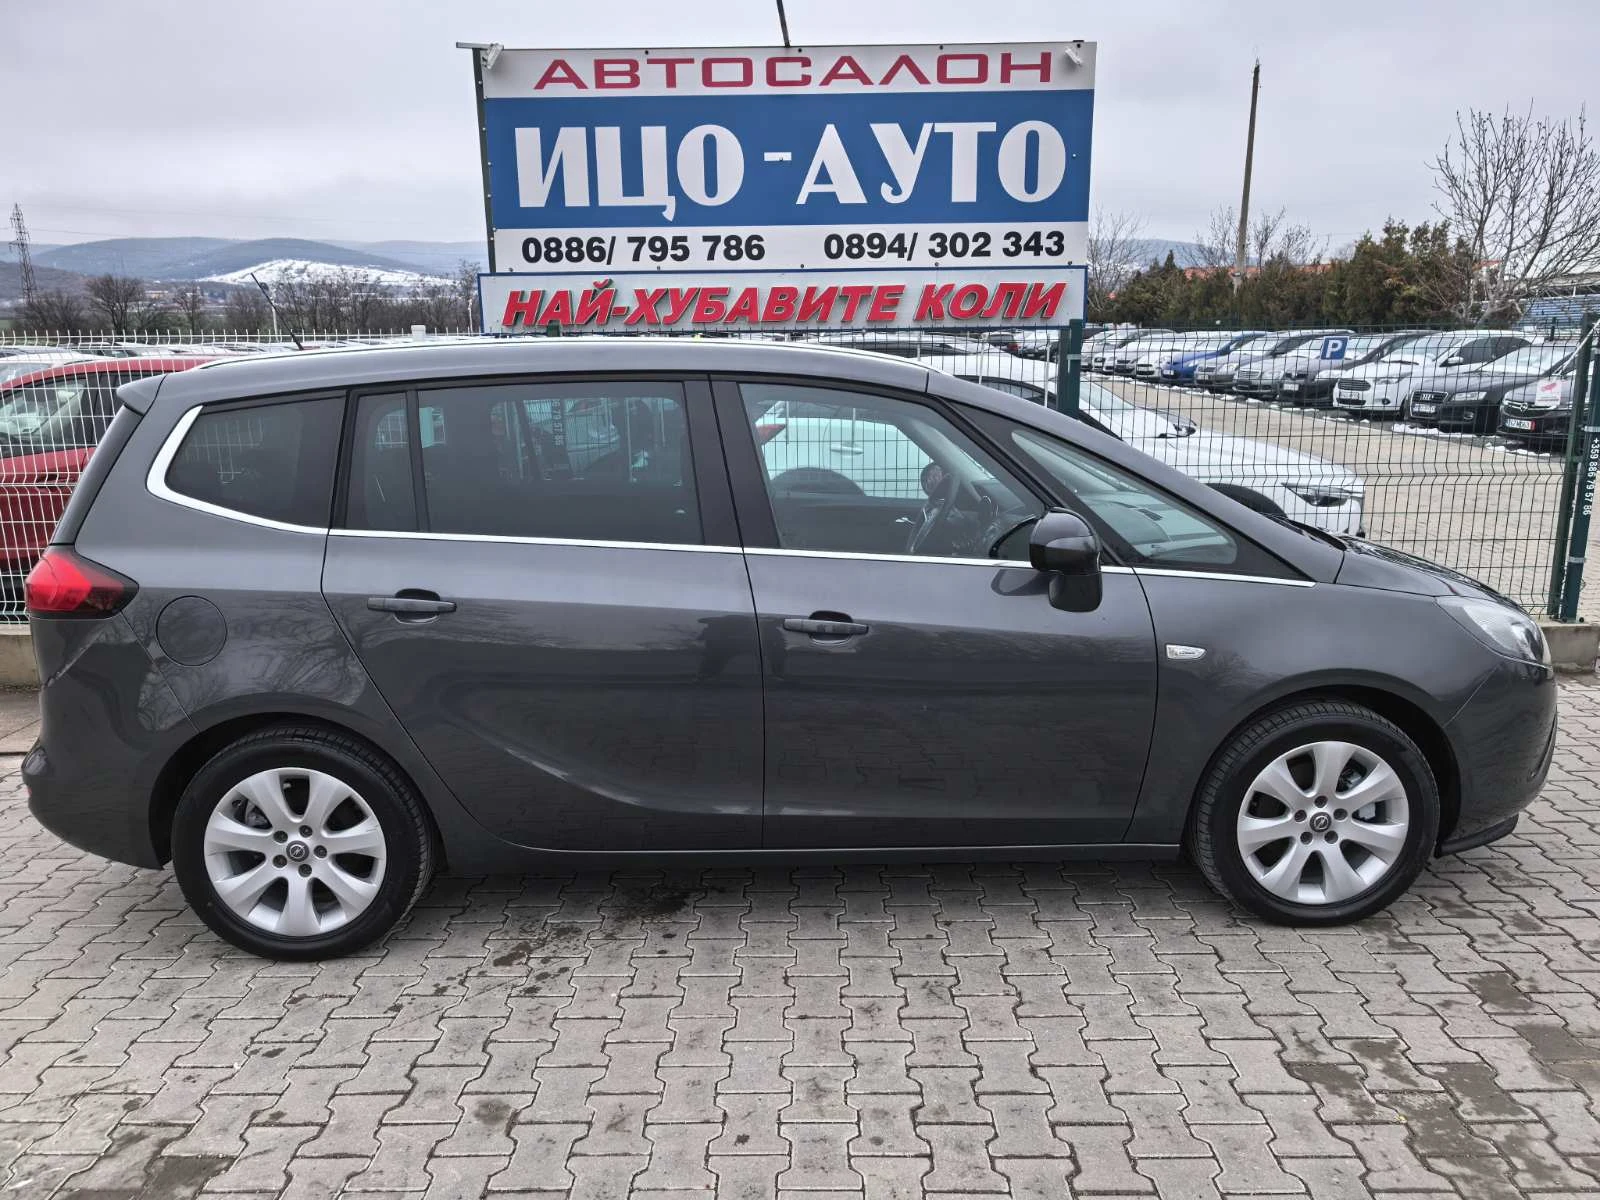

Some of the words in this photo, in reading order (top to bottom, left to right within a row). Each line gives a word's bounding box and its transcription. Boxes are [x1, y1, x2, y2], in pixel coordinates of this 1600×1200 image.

[534, 53, 1051, 90] АВТОСАЛОН
[521, 236, 617, 266] 0886/
[627, 235, 690, 262] 795
[702, 234, 766, 261] 786
[824, 232, 919, 262] 0894/
[928, 231, 992, 258] 302
[1002, 230, 1065, 257] 343
[502, 278, 906, 327] НАЙ-ХУБАВИТЕ
[914, 282, 1067, 321] КОЛИ
[1325, 339, 1343, 359] P
[1590, 437, 1600, 459] +359
[1587, 461, 1598, 478] 886
[1585, 480, 1596, 490] 79
[1584, 492, 1594, 503] 57
[1582, 504, 1592, 516] 86
